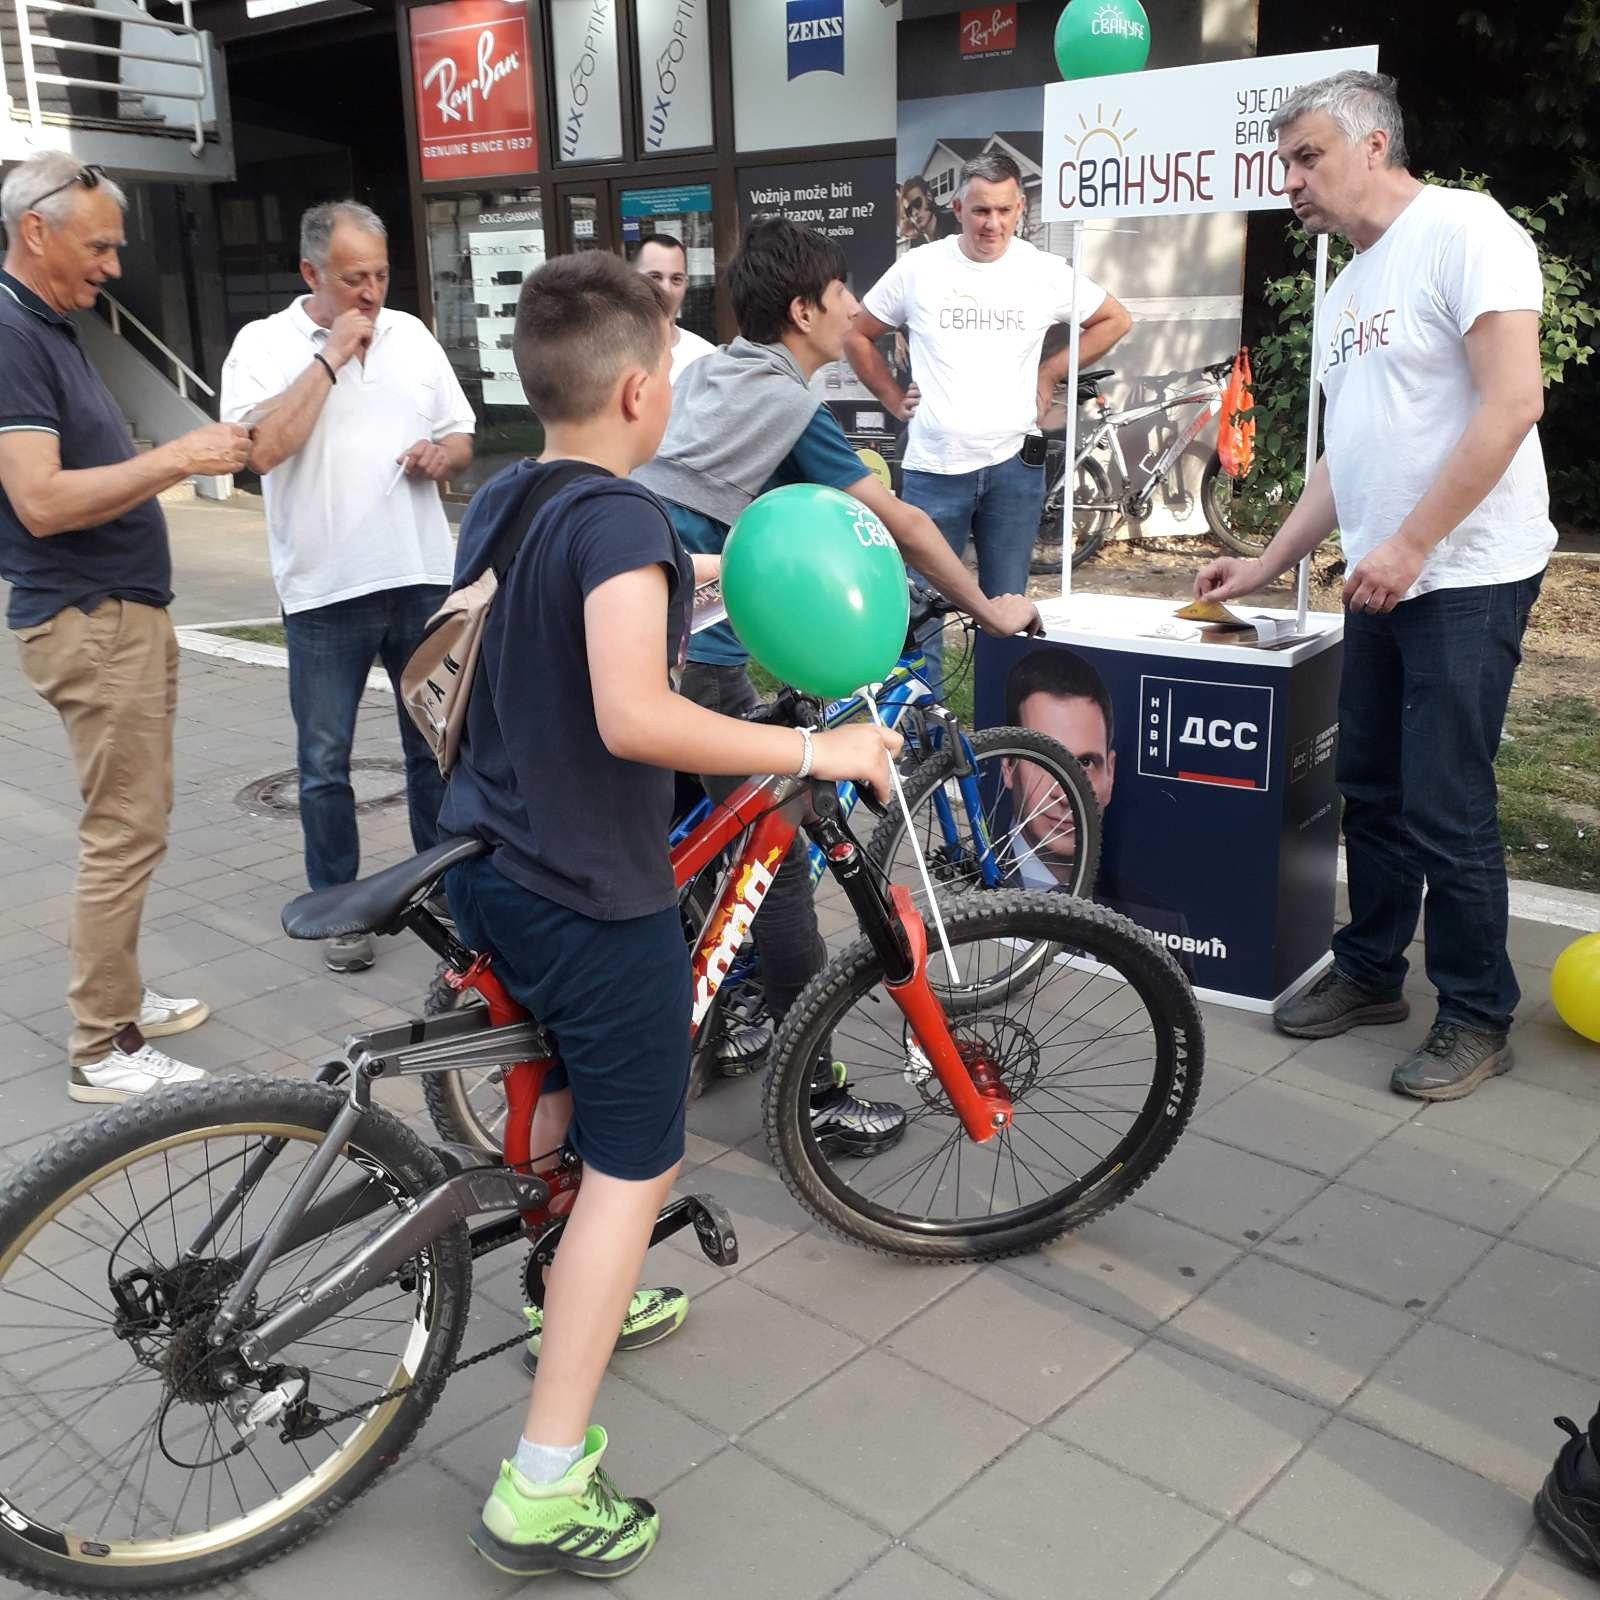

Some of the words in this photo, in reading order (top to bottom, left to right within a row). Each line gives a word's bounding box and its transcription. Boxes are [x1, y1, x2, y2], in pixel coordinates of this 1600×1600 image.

[788, 16, 843, 43] ZEISS
[471, 139, 504, 153] SINCE
[750, 187, 791, 206] Vožnja
[794, 184, 828, 200] može
[831, 181, 853, 198] biti
[1058, 150, 1216, 209] СВАНУЋЕ
[828, 207, 849, 220] zar
[852, 202, 875, 218] ne?
[940, 308, 1026, 331] СВАНУЋЕ
[1149, 696, 1160, 757] НОВИ
[1179, 716, 1259, 751] ДСС
[1145, 929, 1227, 959] новић
[1166, 1025, 1188, 1118] MAXXIS
